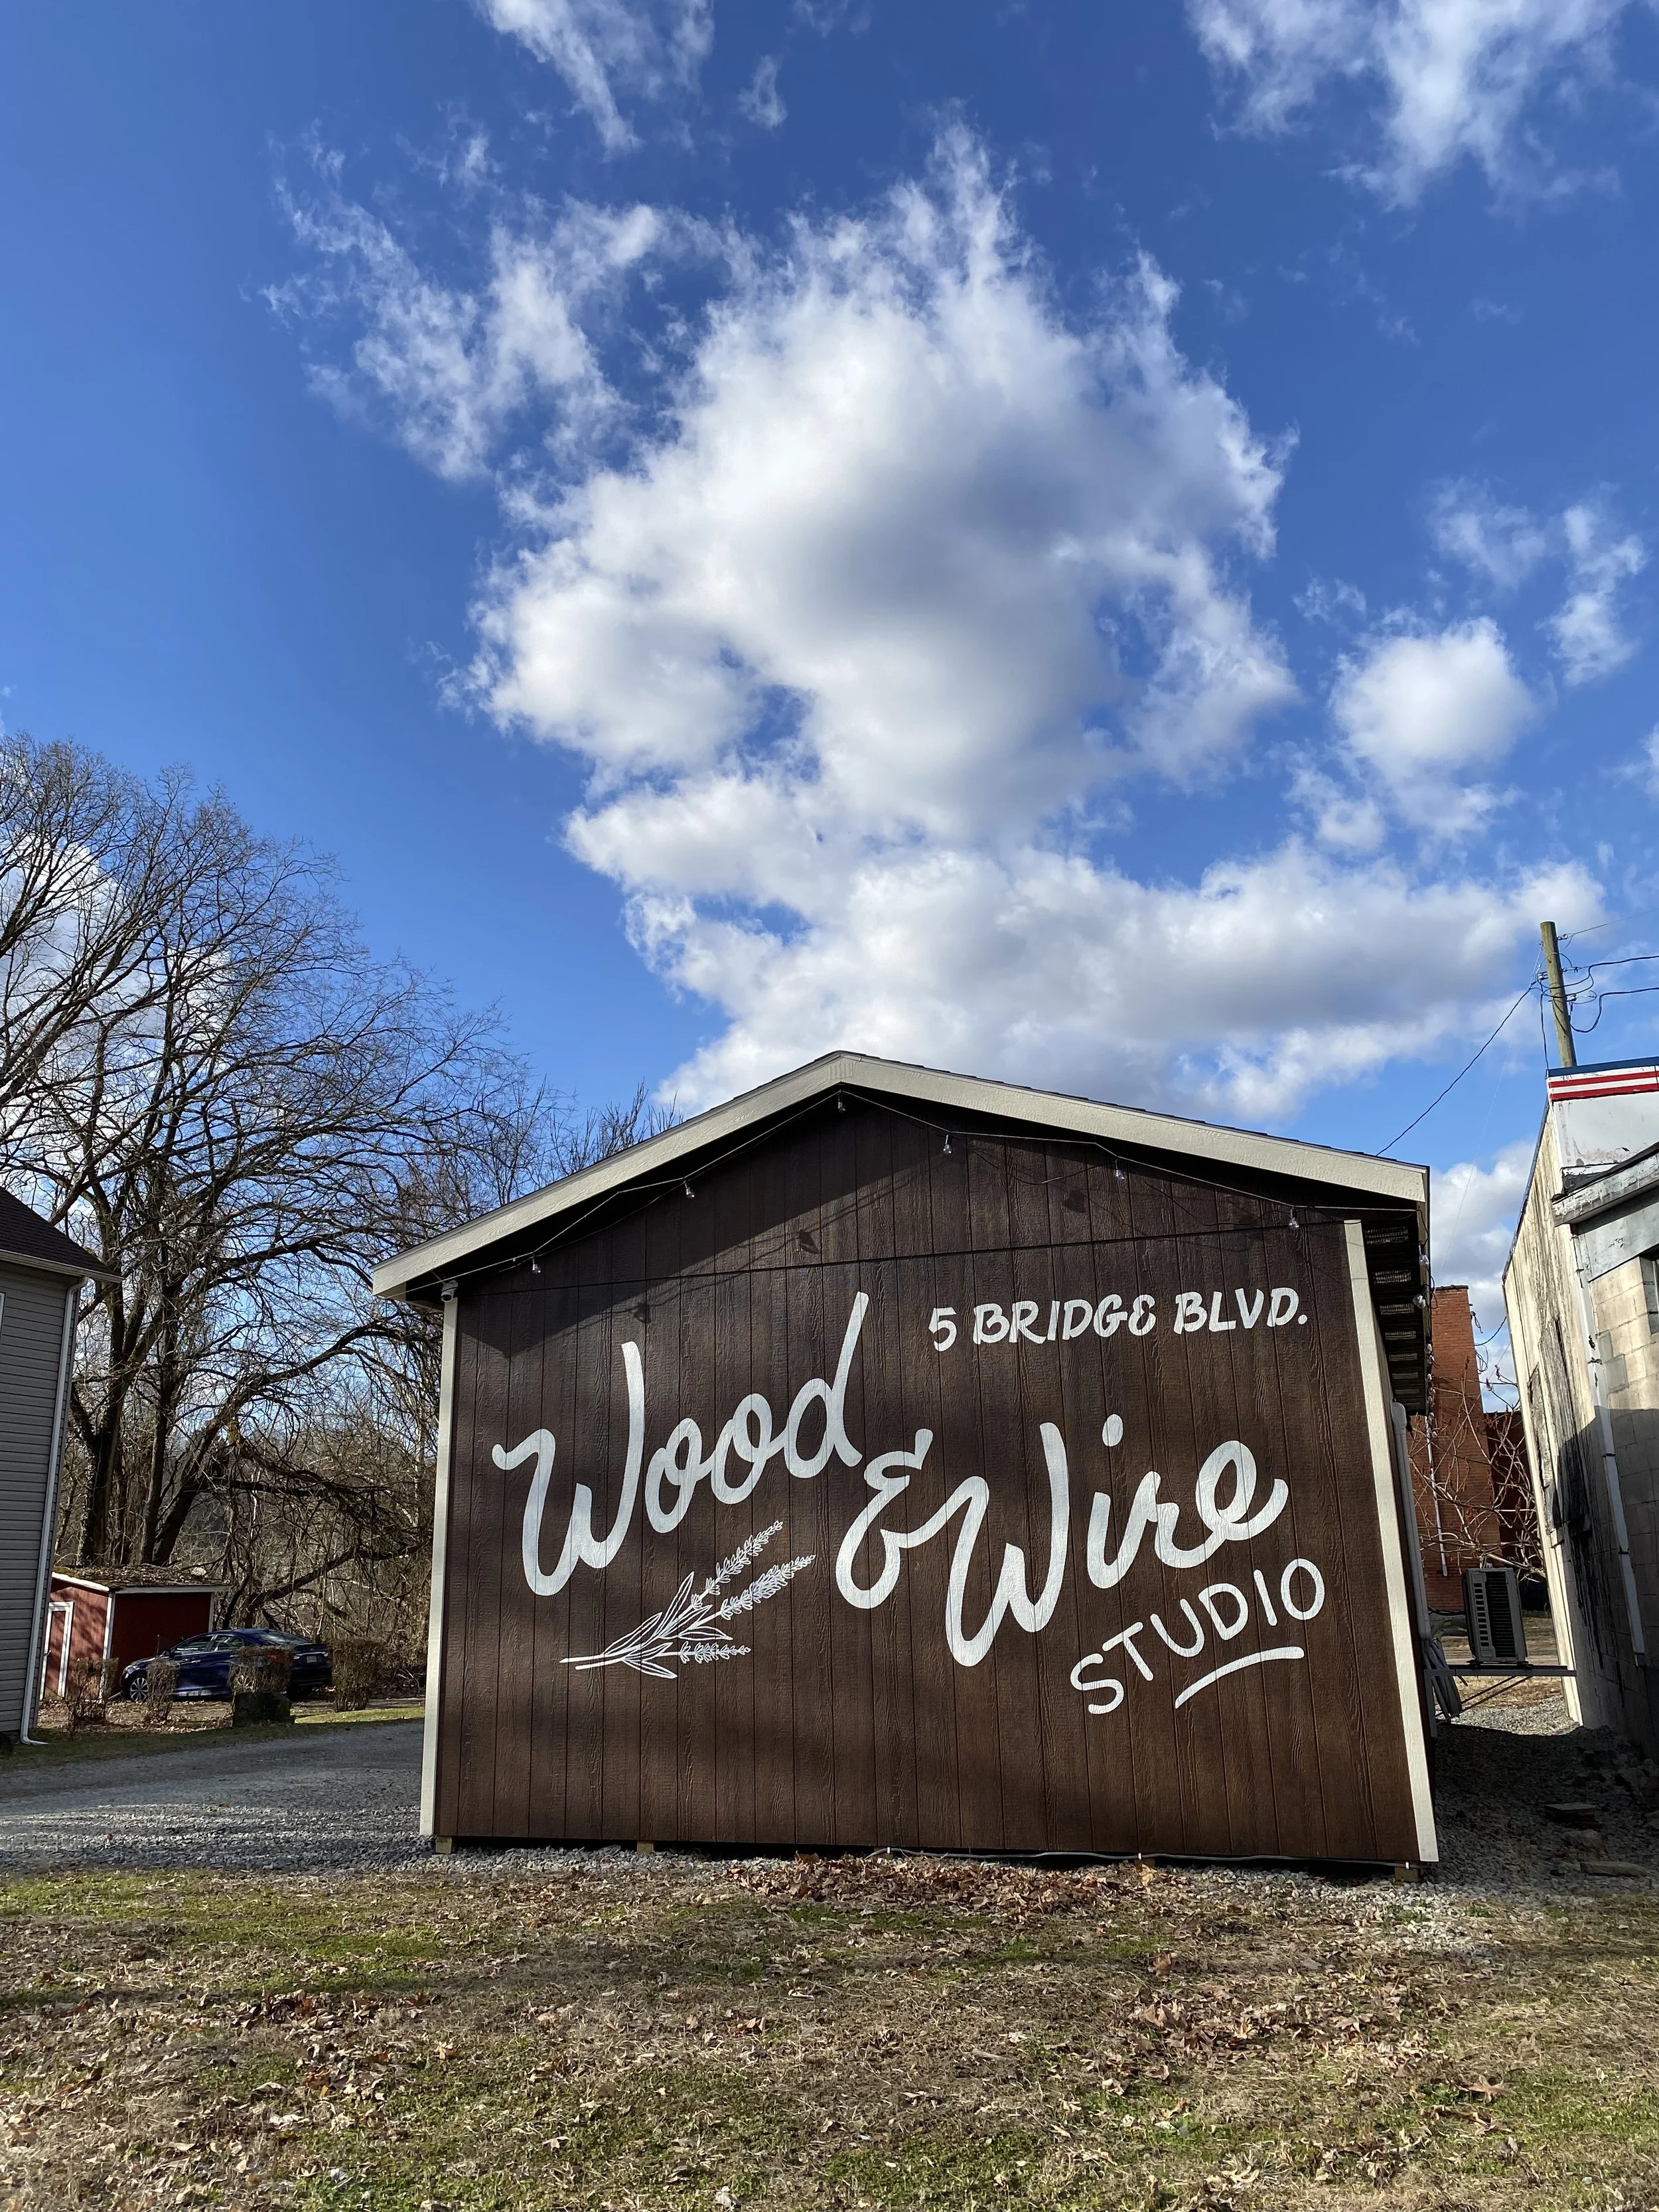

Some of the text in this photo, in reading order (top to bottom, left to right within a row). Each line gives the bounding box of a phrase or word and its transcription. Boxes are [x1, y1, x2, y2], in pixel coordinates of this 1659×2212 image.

[928, 1287, 1309, 1352] 5 BRIDGE BLVD.
[492, 1291, 1289, 1667] Wood & Wire
[1070, 1558, 1325, 1715] STUDIO
